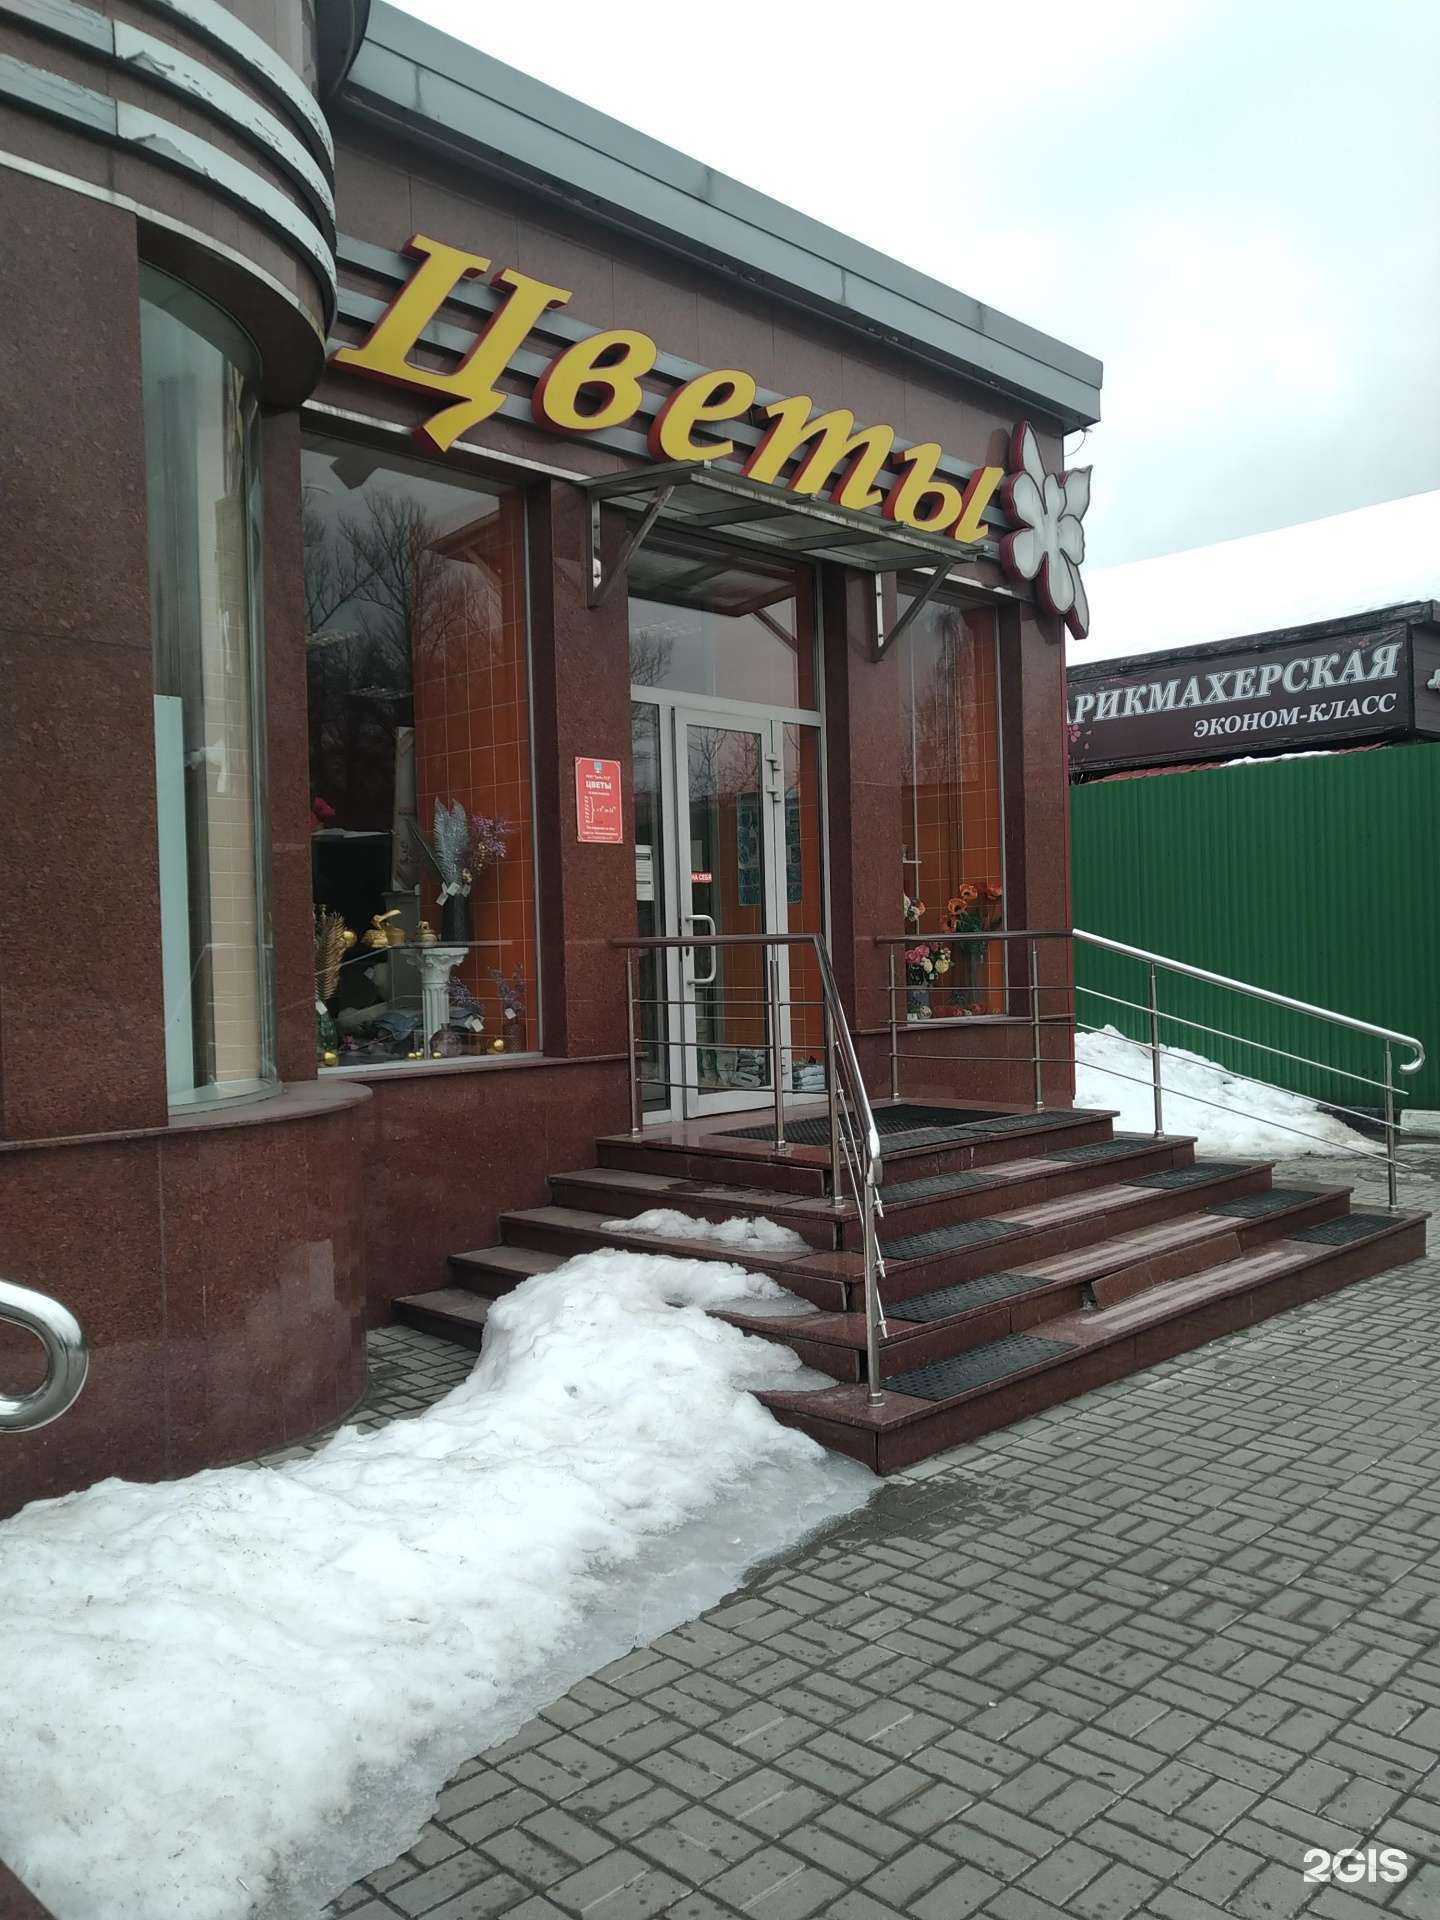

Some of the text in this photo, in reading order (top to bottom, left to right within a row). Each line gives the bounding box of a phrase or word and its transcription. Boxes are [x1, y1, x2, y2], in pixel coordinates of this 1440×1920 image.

[331, 233, 1005, 542] Цветы
[1067, 642, 1403, 725] РИКМАХЕРСКАЯ
[1193, 693, 1397, 738] ЭКОНОМ-КЛАСС
[585, 781, 611, 791] ЦВЕТЫ
